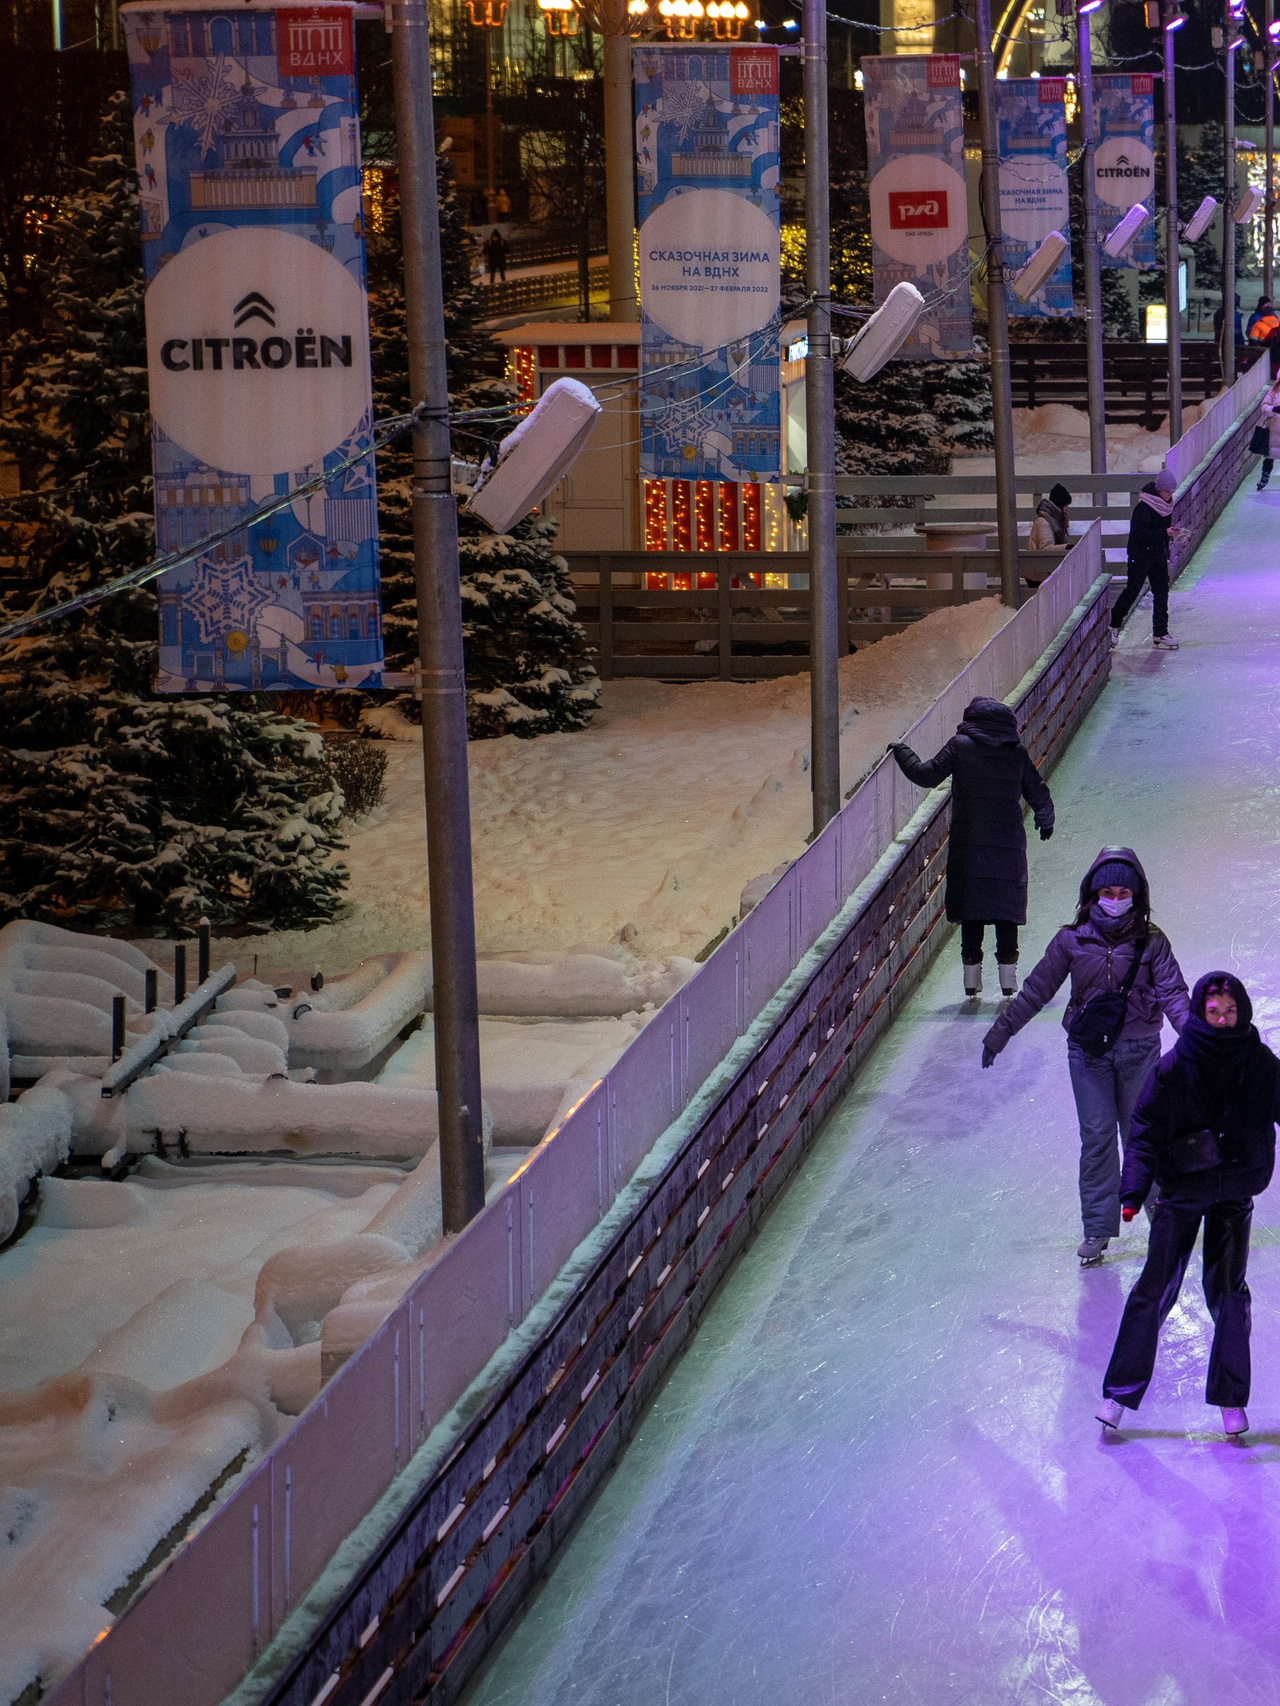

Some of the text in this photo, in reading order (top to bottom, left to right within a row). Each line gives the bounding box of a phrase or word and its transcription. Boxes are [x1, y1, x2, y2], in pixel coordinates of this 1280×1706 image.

[290, 51, 344, 67] ВДНХ
[737, 78, 773, 89] ВДНХ
[1096, 165, 1150, 178] CITROËN
[649, 250, 770, 263] СКАЗОЧНАЯ ЗИМА
[682, 267, 740, 279] НА ВДНХ
[160, 327, 353, 373] CITROËN
